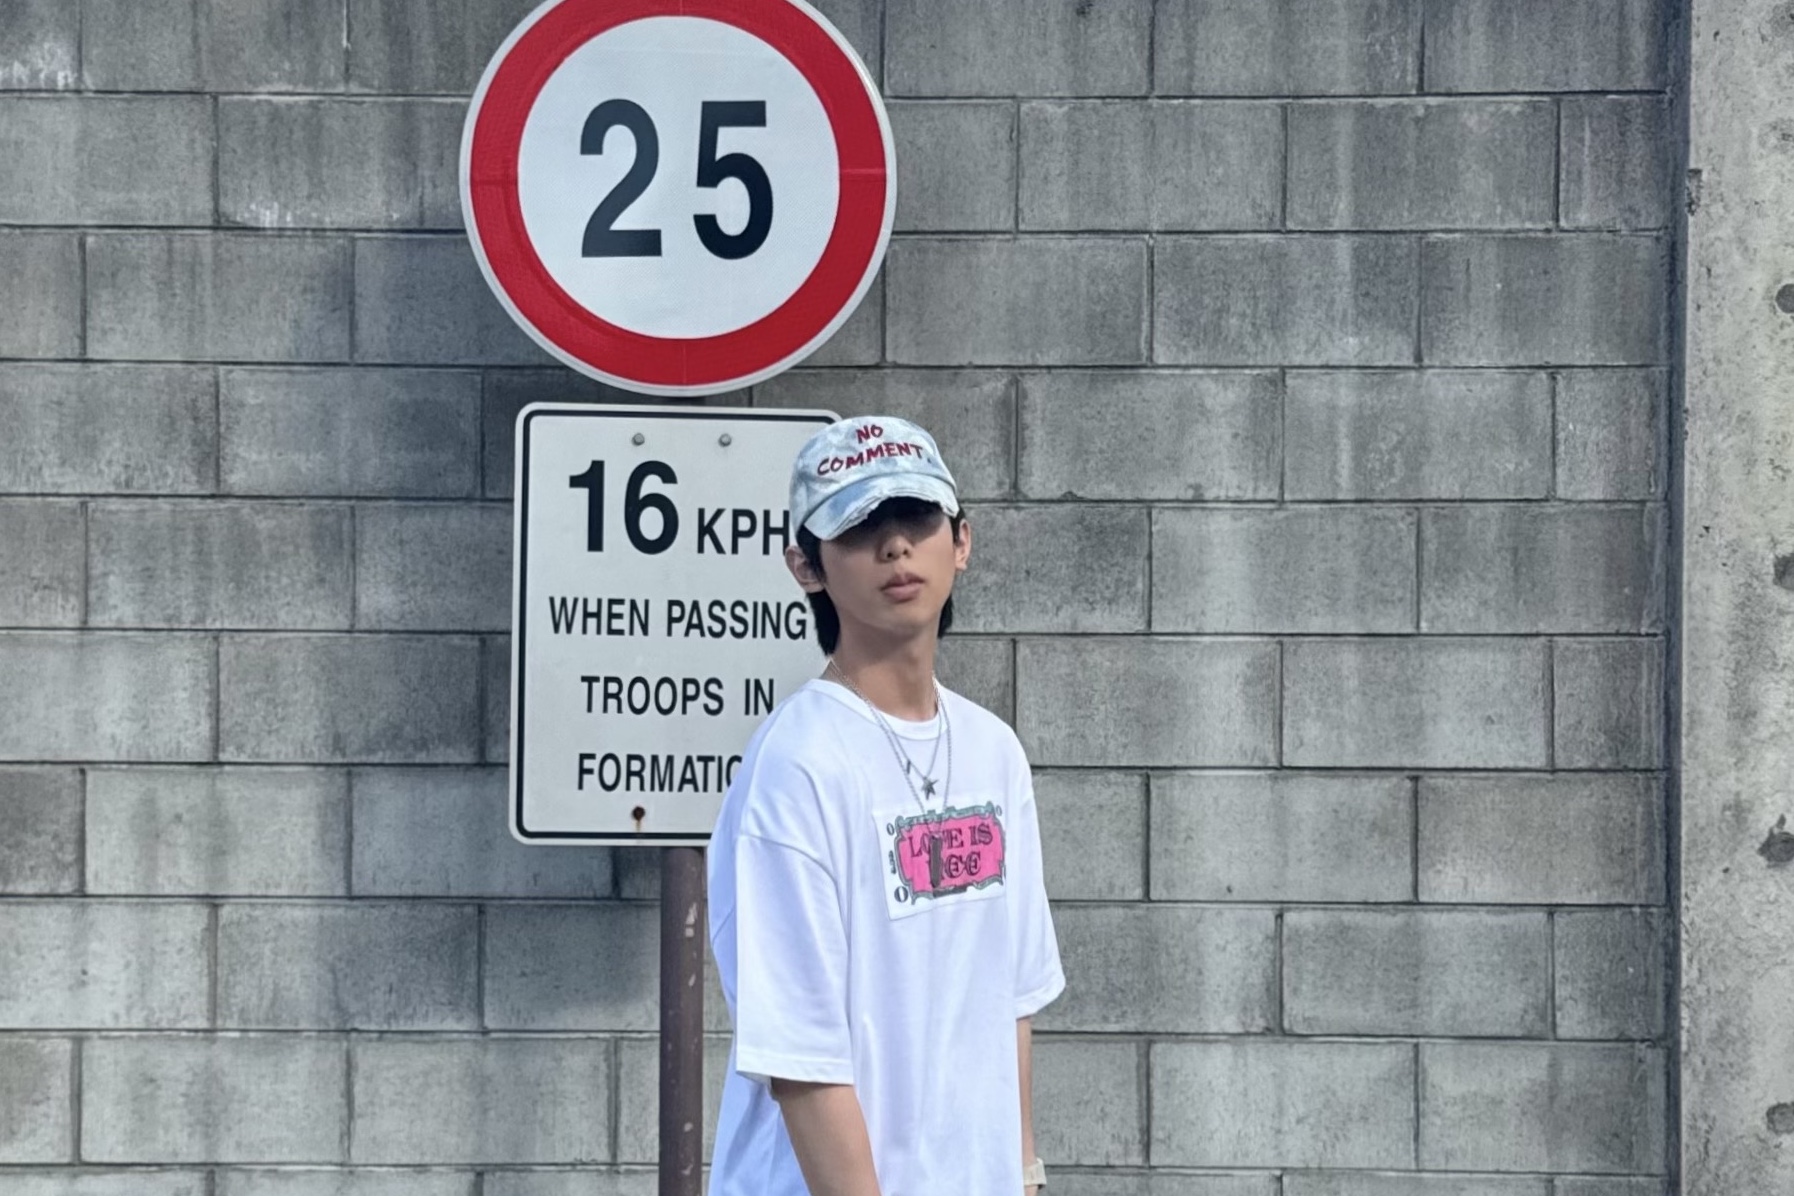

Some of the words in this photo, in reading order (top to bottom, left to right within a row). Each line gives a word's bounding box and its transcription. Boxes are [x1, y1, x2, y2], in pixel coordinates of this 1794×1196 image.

[580, 98, 774, 260] 25
[855, 424, 884, 444] NO
[569, 460, 679, 555] 16
[697, 508, 790, 556] KPH
[549, 597, 650, 637] WHEN
[666, 600, 807, 641] PASSING
[580, 676, 724, 717] TROOPS
[744, 678, 775, 716] IN
[908, 828, 964, 858] LOE
[968, 823, 994, 846] IS
